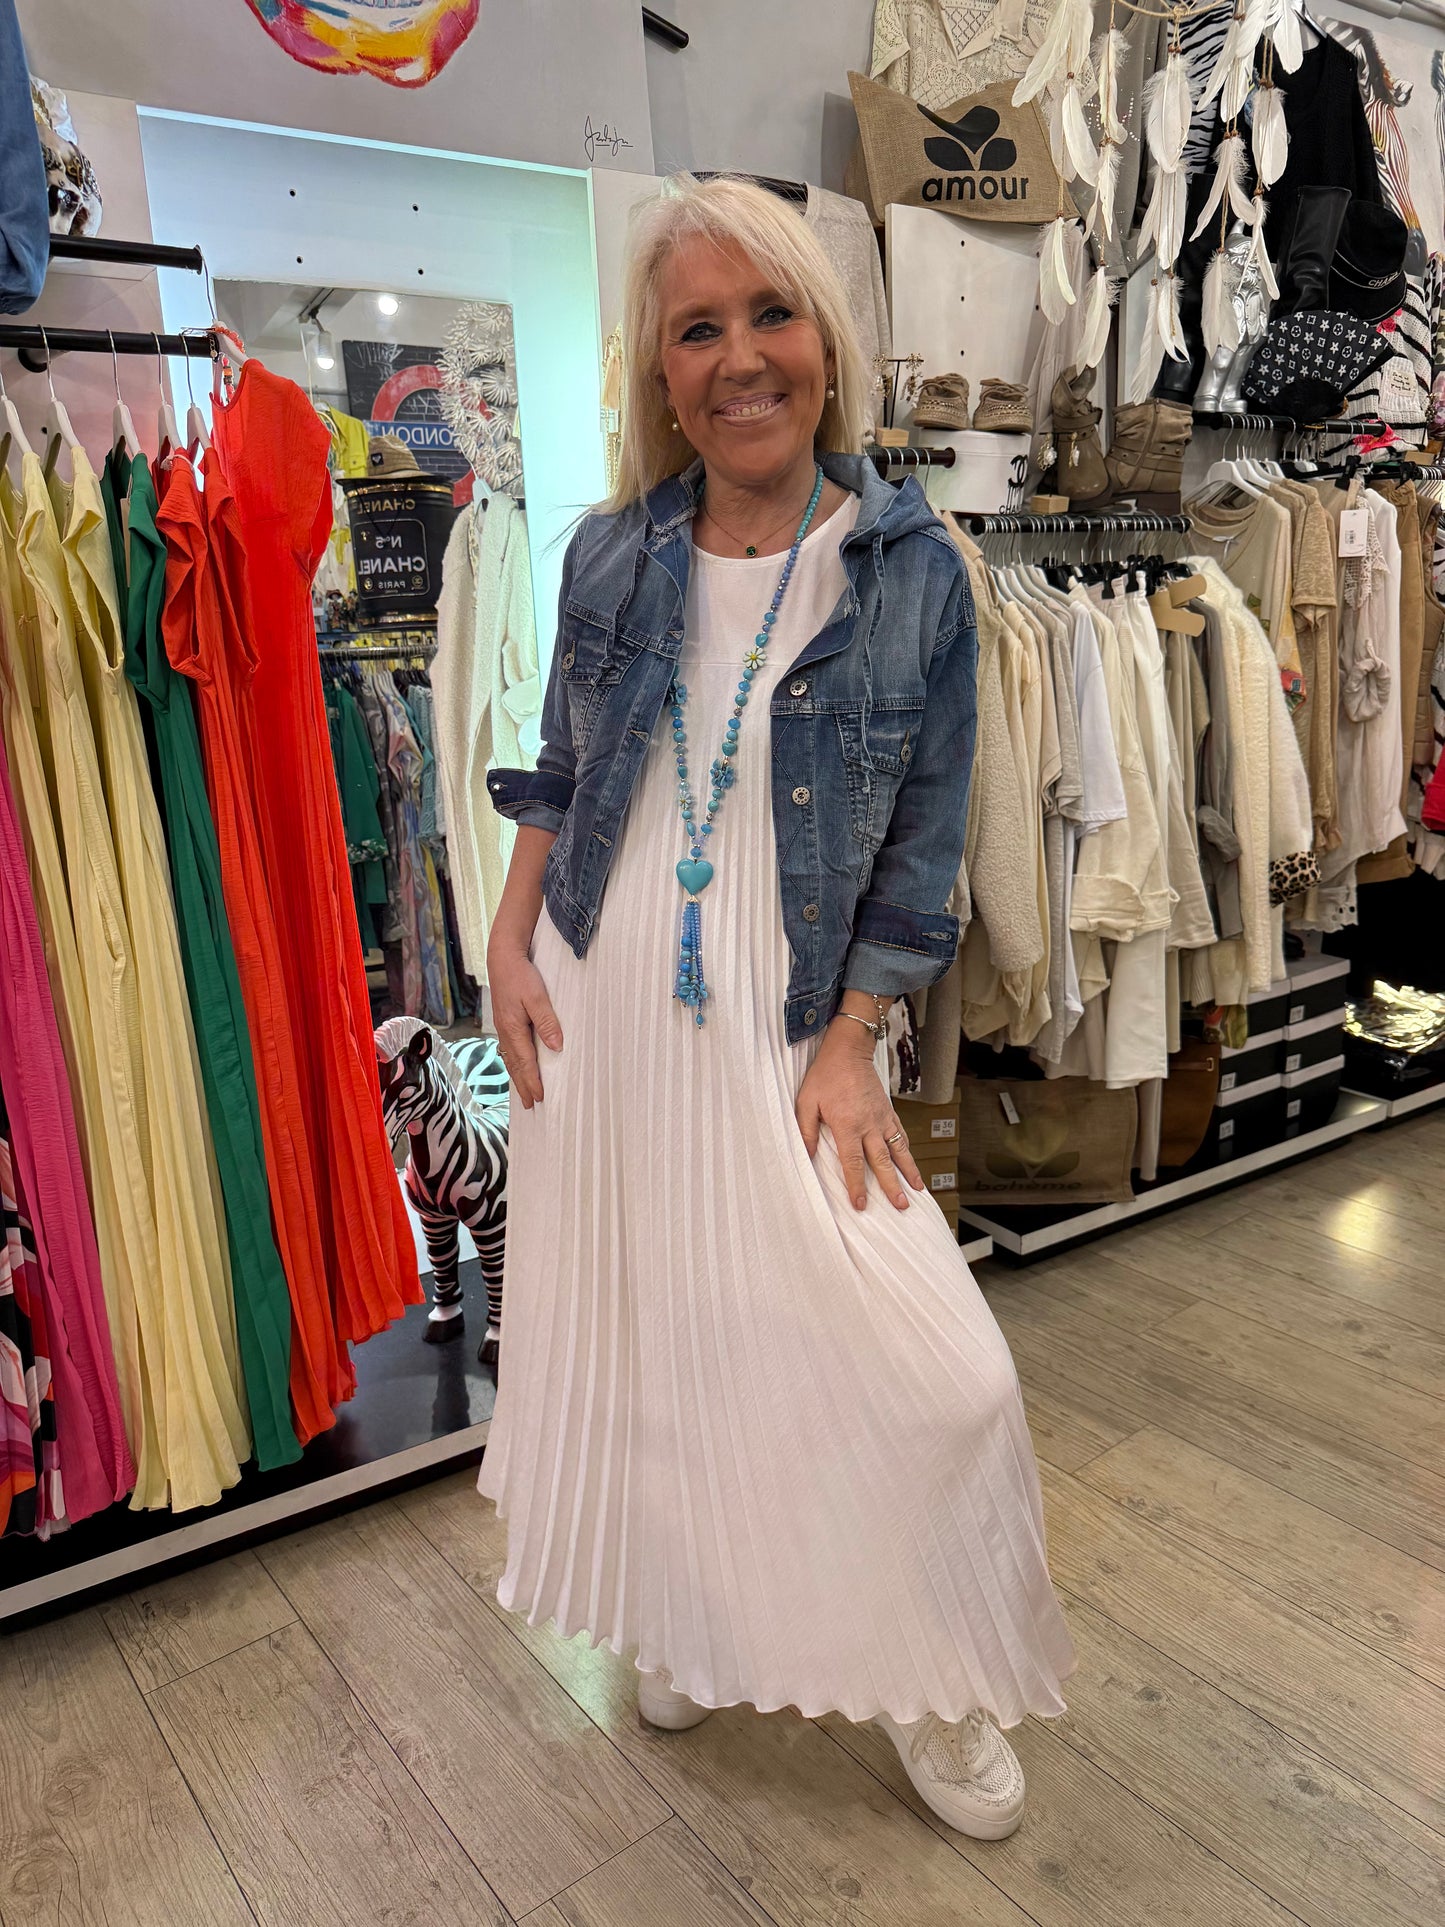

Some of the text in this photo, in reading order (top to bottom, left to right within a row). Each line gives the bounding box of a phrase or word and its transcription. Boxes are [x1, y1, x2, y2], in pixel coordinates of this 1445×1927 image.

[922, 175, 1029, 202] amour
[942, 1120, 953, 1129] 36
[942, 1175, 953, 1184] 39
